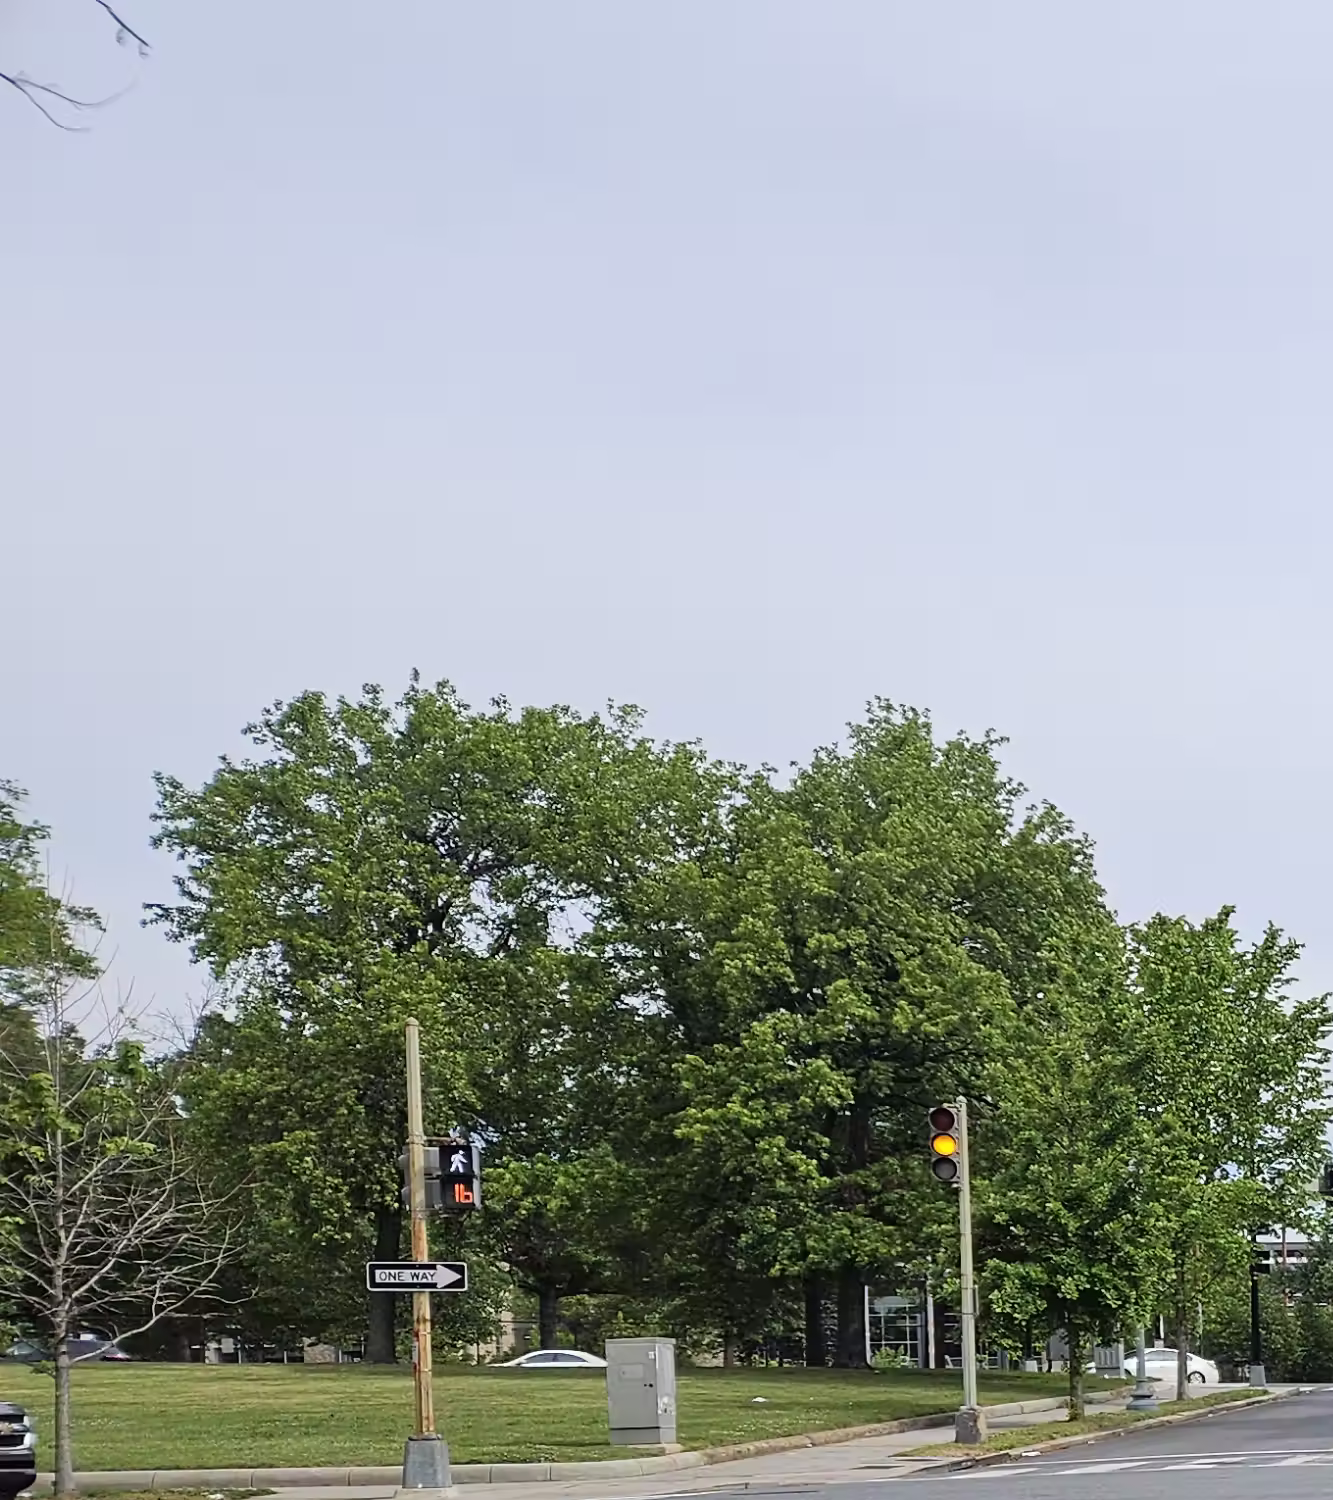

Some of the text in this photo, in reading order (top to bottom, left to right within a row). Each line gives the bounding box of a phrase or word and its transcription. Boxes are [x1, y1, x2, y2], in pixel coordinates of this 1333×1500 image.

[455, 1184, 472, 1202] 16
[379, 1272, 436, 1281] ONE WAY
